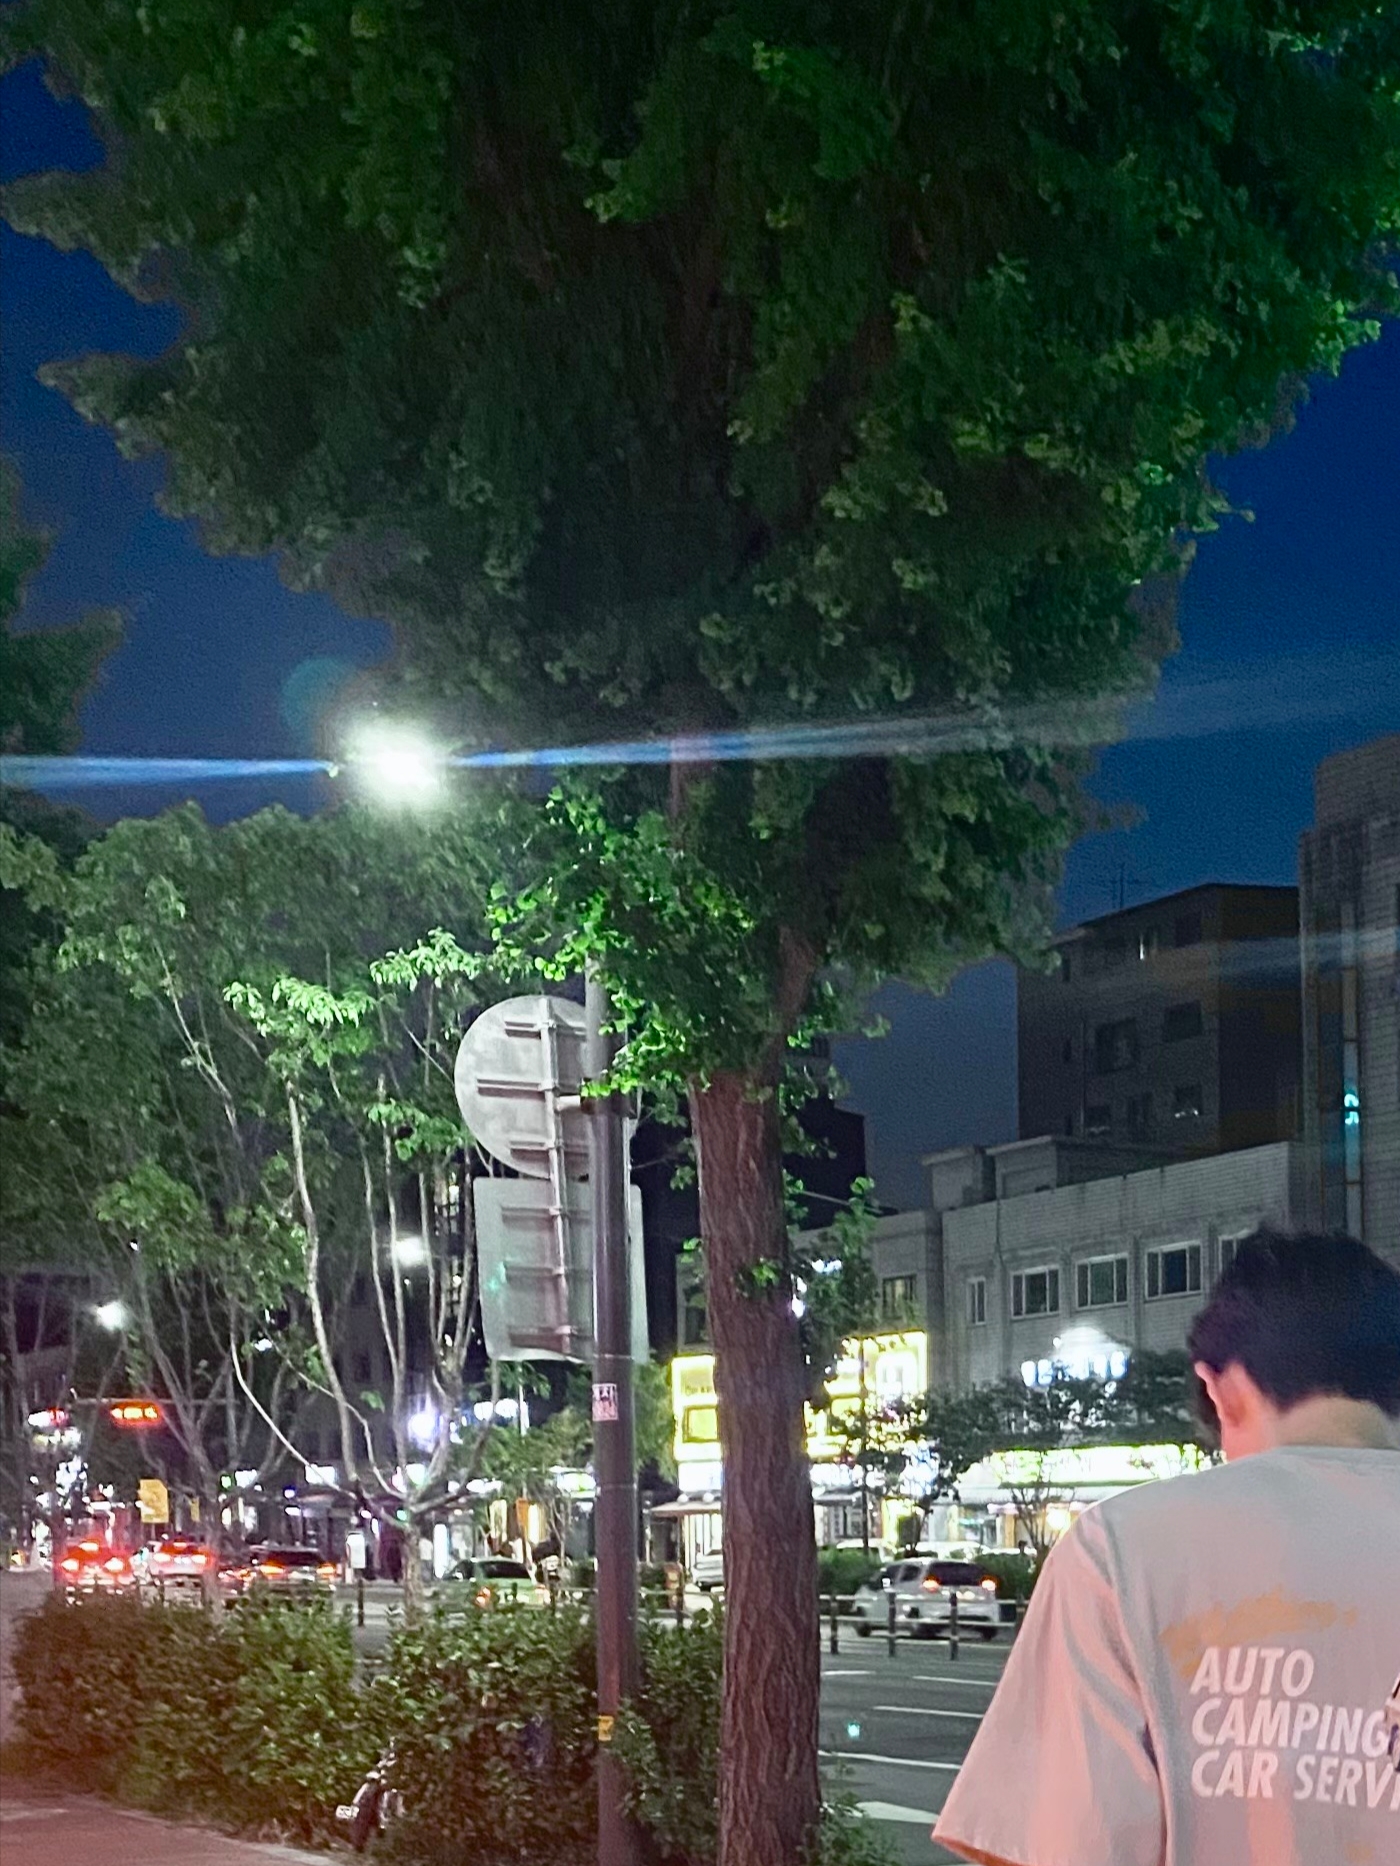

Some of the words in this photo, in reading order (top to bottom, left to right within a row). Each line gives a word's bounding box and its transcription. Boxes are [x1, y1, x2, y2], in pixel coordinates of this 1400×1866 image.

[1190, 1646, 1315, 1697] AUTO
[1191, 1697, 1388, 1758] CAMPING
[1191, 1750, 1279, 1798] CAR
